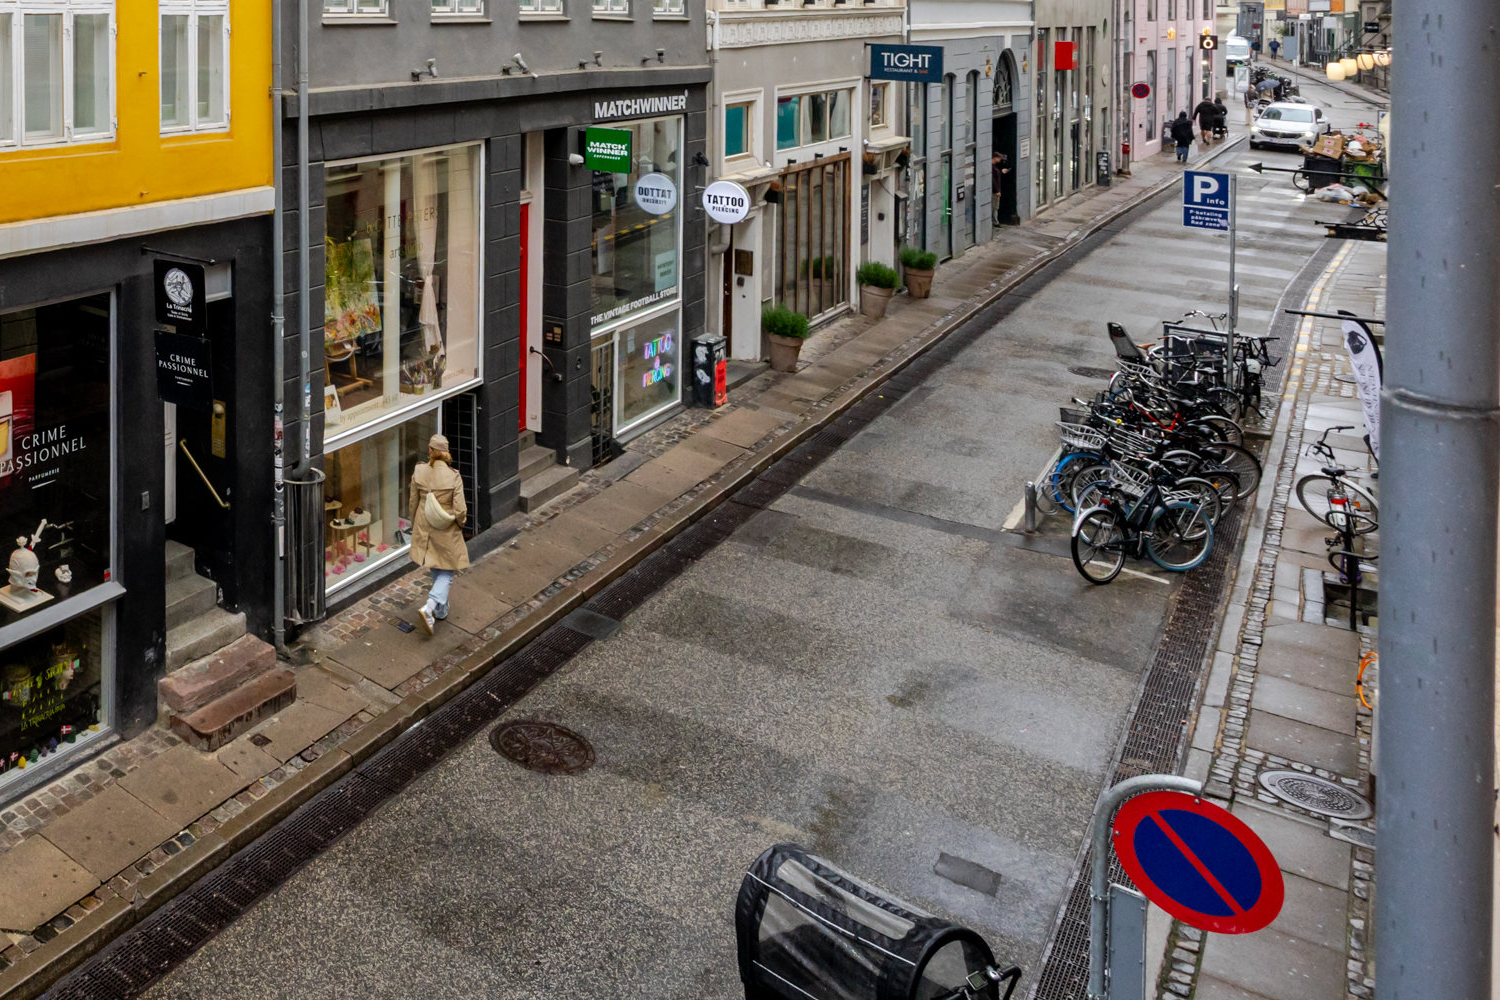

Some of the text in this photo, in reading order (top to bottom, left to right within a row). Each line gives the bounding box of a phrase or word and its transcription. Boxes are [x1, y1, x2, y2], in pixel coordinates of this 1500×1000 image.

[881, 52, 932, 68] TIGHT
[594, 95, 686, 119] MATCHWINNER
[587, 147, 628, 156] WINNER
[589, 141, 626, 150] MATCH
[1193, 175, 1219, 202] P
[707, 194, 744, 208] TATTOO
[712, 205, 740, 214] PIERCING
[590, 286, 677, 325] THE VINTAGE FOOTBALL STORE
[644, 333, 672, 360] TATTOO
[169, 353, 196, 366] CRIME
[158, 360, 209, 378] PASSIONNEL
[642, 363, 671, 388] PIERCING
[21, 424, 67, 450] CRIME
[0, 436, 87, 475] PASSIONNEL
[28, 467, 60, 482] PARFUMERIE
